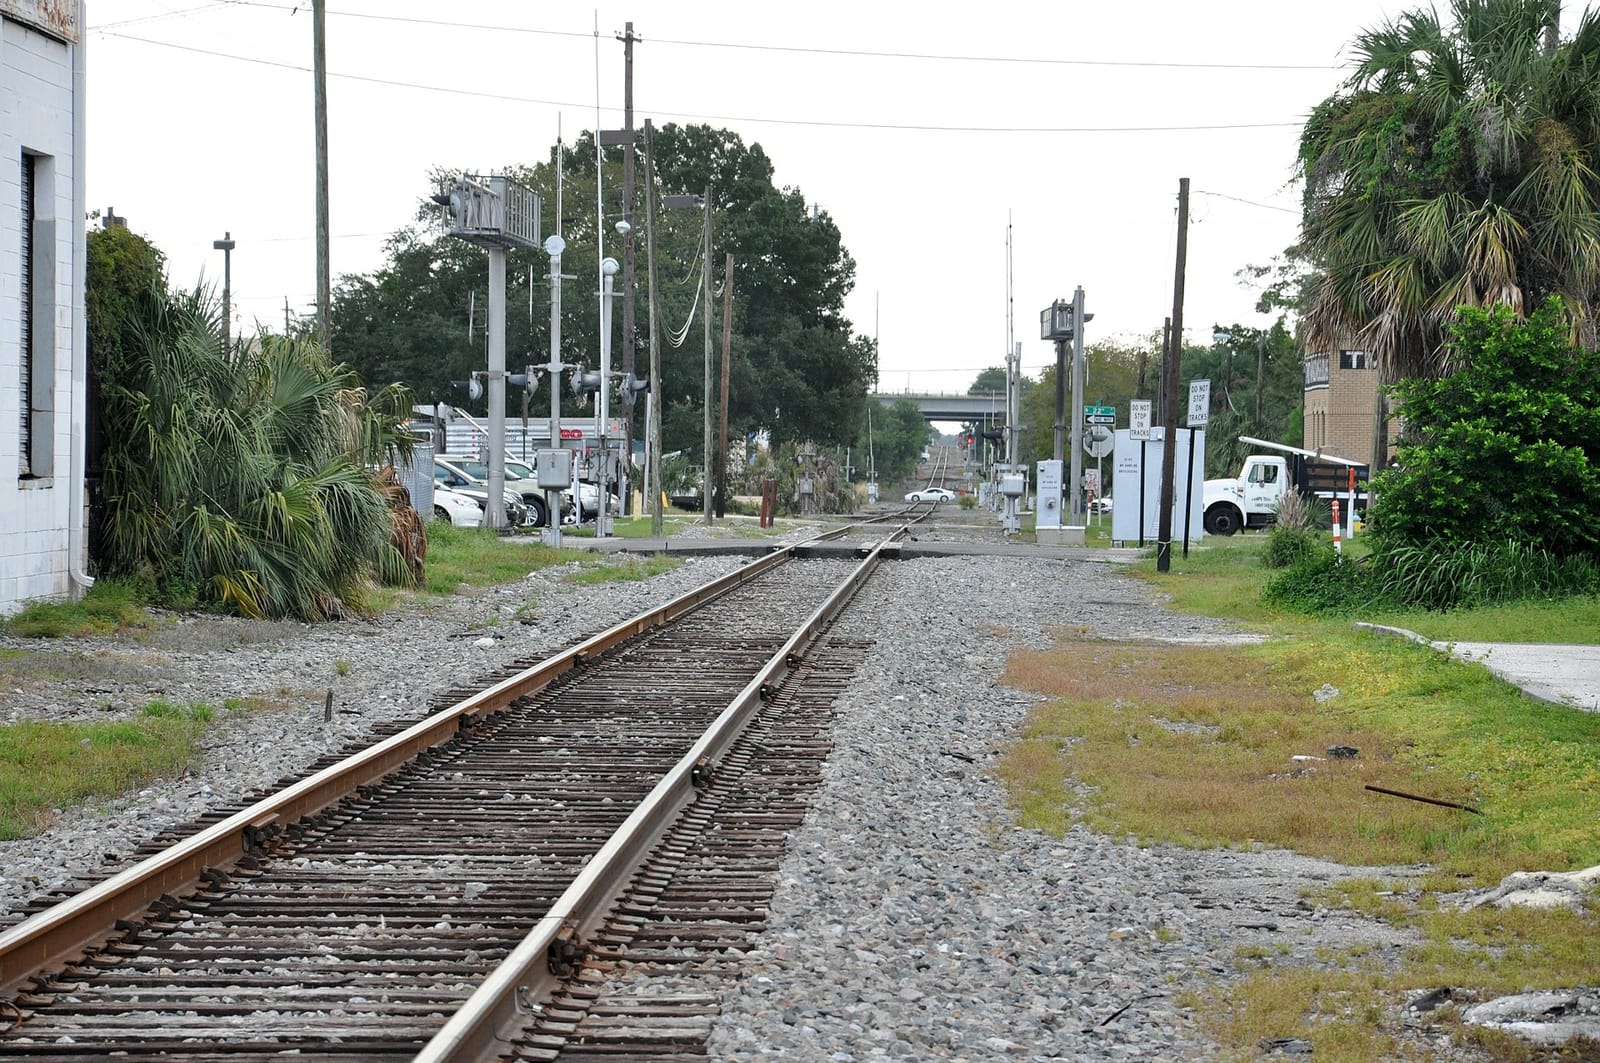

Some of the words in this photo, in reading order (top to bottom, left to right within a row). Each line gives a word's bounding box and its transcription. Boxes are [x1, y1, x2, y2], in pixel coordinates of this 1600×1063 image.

[1191, 385, 1198, 393] DO
[1199, 384, 1208, 392] NOT
[1193, 394, 1205, 402] STOP
